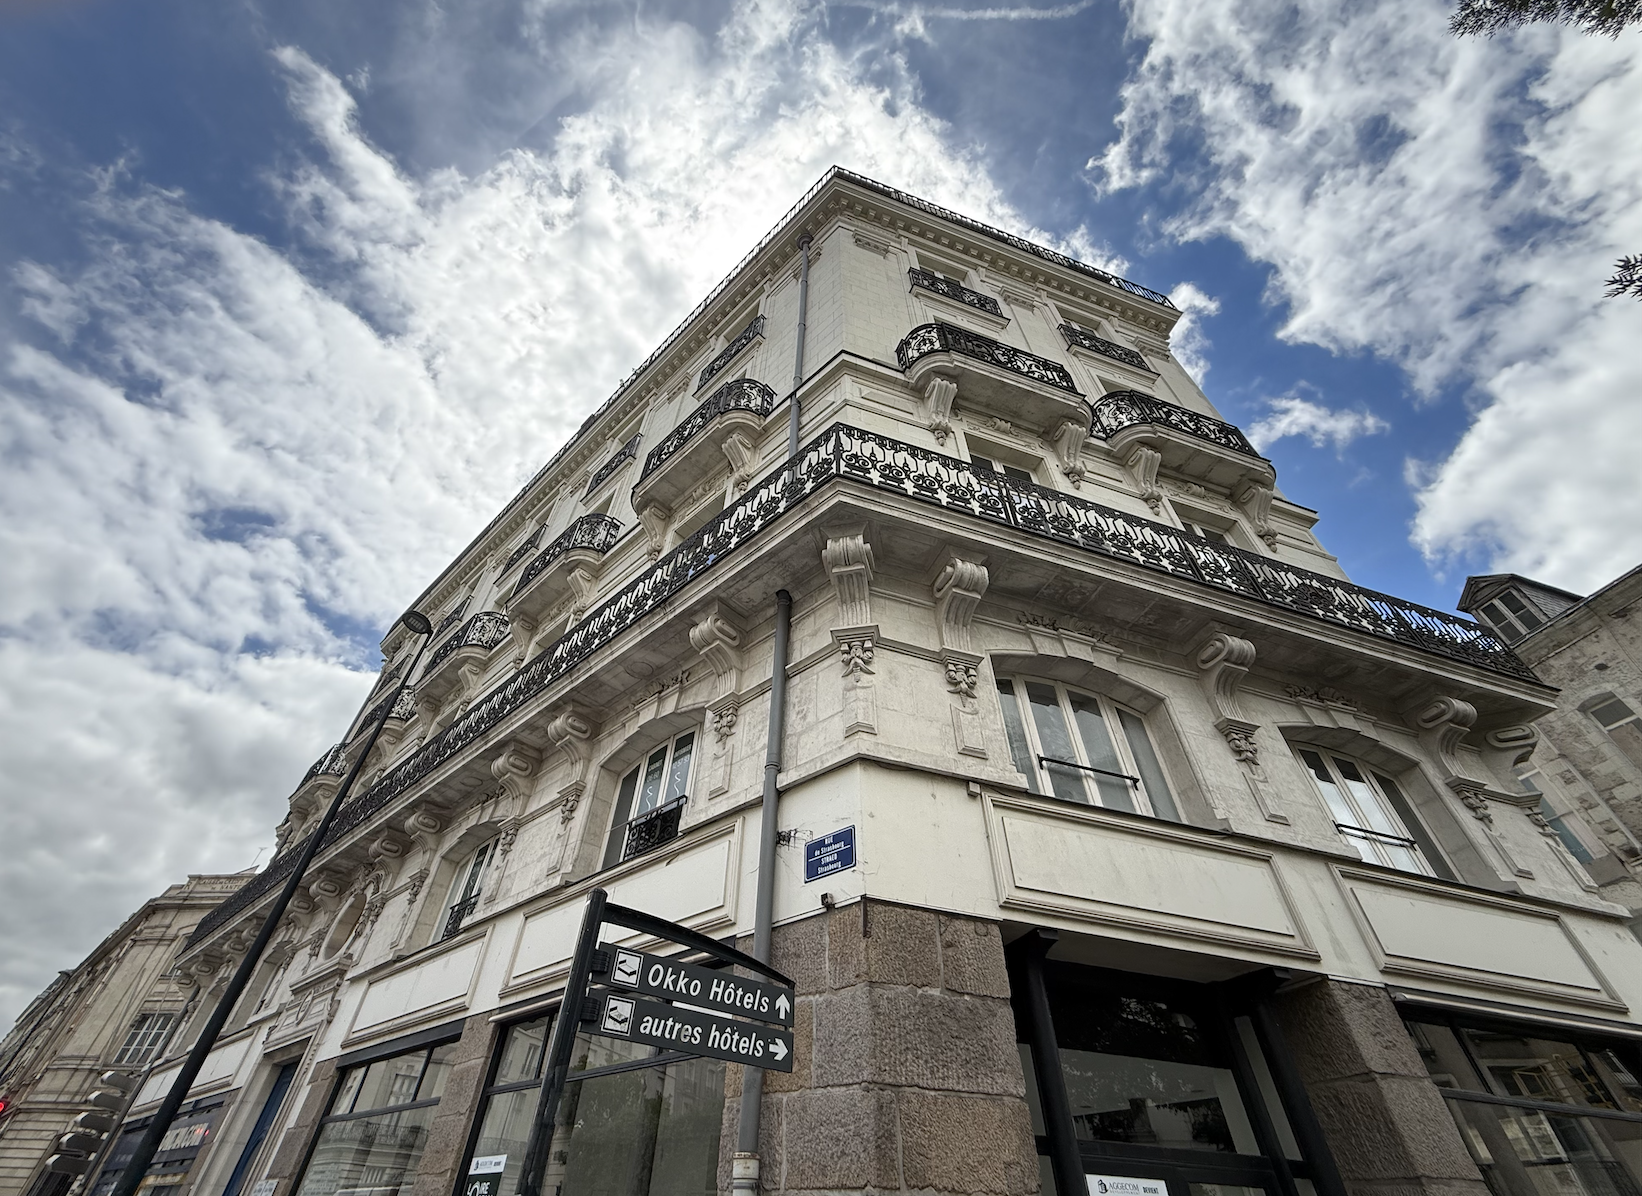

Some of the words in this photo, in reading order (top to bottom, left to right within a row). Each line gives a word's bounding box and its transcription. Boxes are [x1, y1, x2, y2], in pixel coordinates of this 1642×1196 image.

[825, 836, 833, 845] RUE
[821, 841, 844, 854] Strasbourg
[817, 861, 841, 874] Strasbourg
[648, 964, 701, 996] Okko
[709, 979, 769, 1013] Hôtels
[640, 1016, 702, 1045] autres
[708, 1024, 764, 1057] hôtels
[1109, 1182, 1139, 1191] AGGECOM
